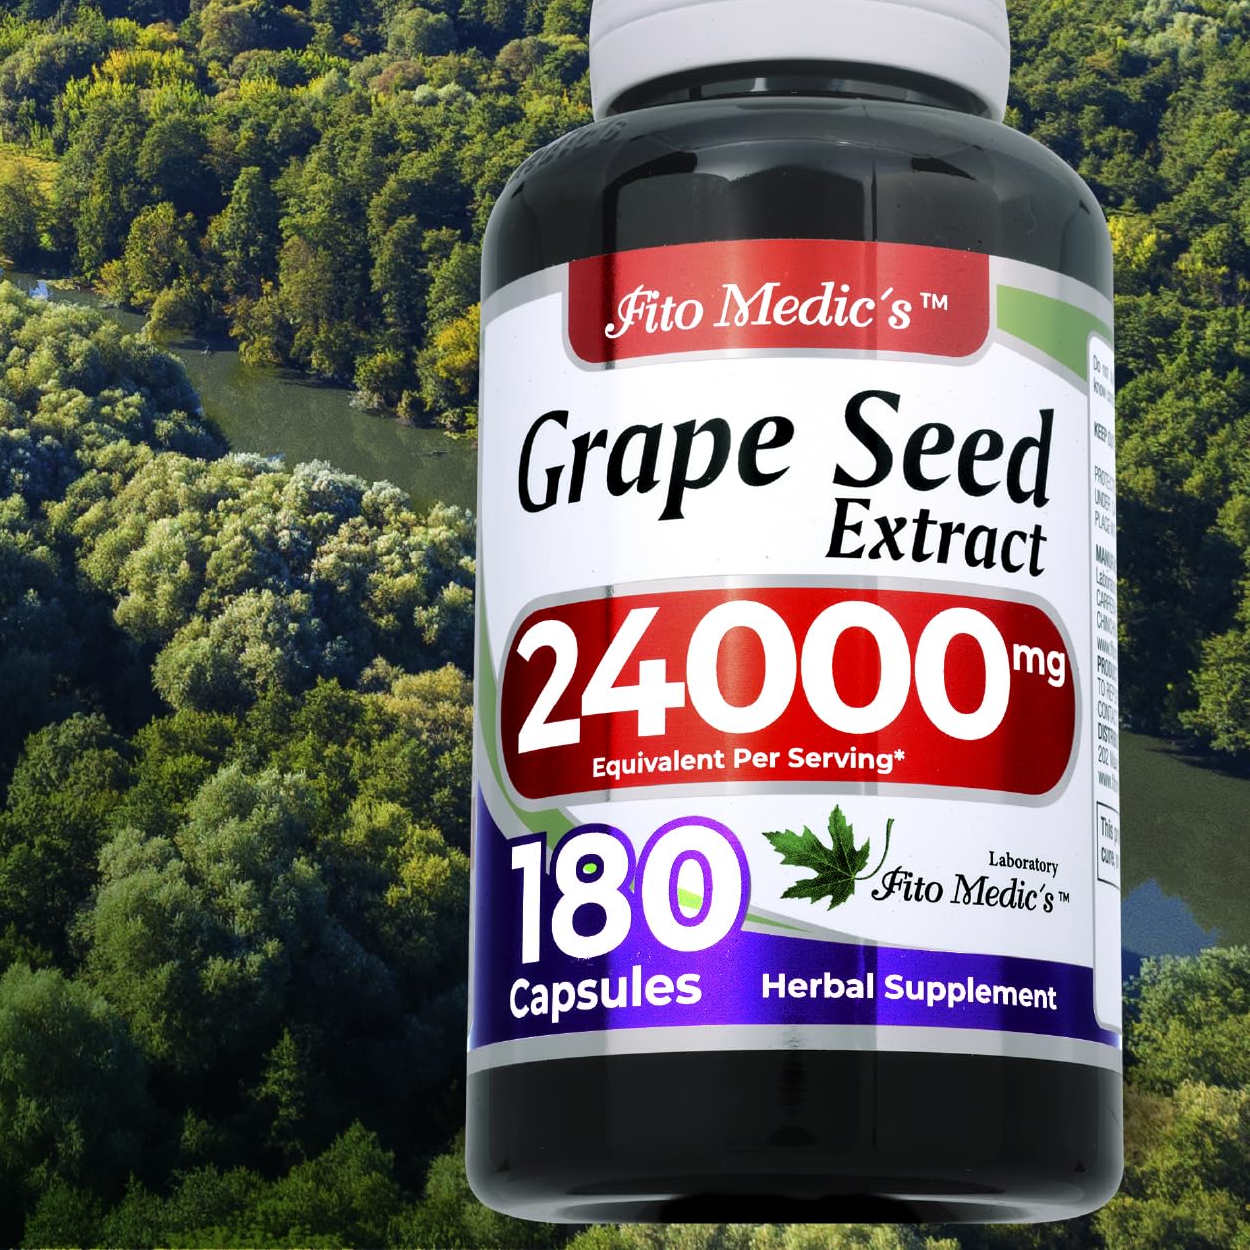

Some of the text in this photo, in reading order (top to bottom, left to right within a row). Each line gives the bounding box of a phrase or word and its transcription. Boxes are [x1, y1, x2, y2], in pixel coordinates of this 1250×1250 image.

[605, 285, 703, 338] Fito
[519, 390, 1054, 521] Grape Seed
[826, 498, 1046, 577] Extract
[517, 599, 1065, 753] 24000 mg
[592, 750, 725, 777] Equivalent
[734, 748, 780, 768] Per
[512, 818, 744, 963] 180
[871, 866, 943, 903] Fito
[989, 851, 1058, 878] Laboratory
[510, 966, 702, 1023] Capsules
[762, 972, 1057, 1009] Herbal Supplement
